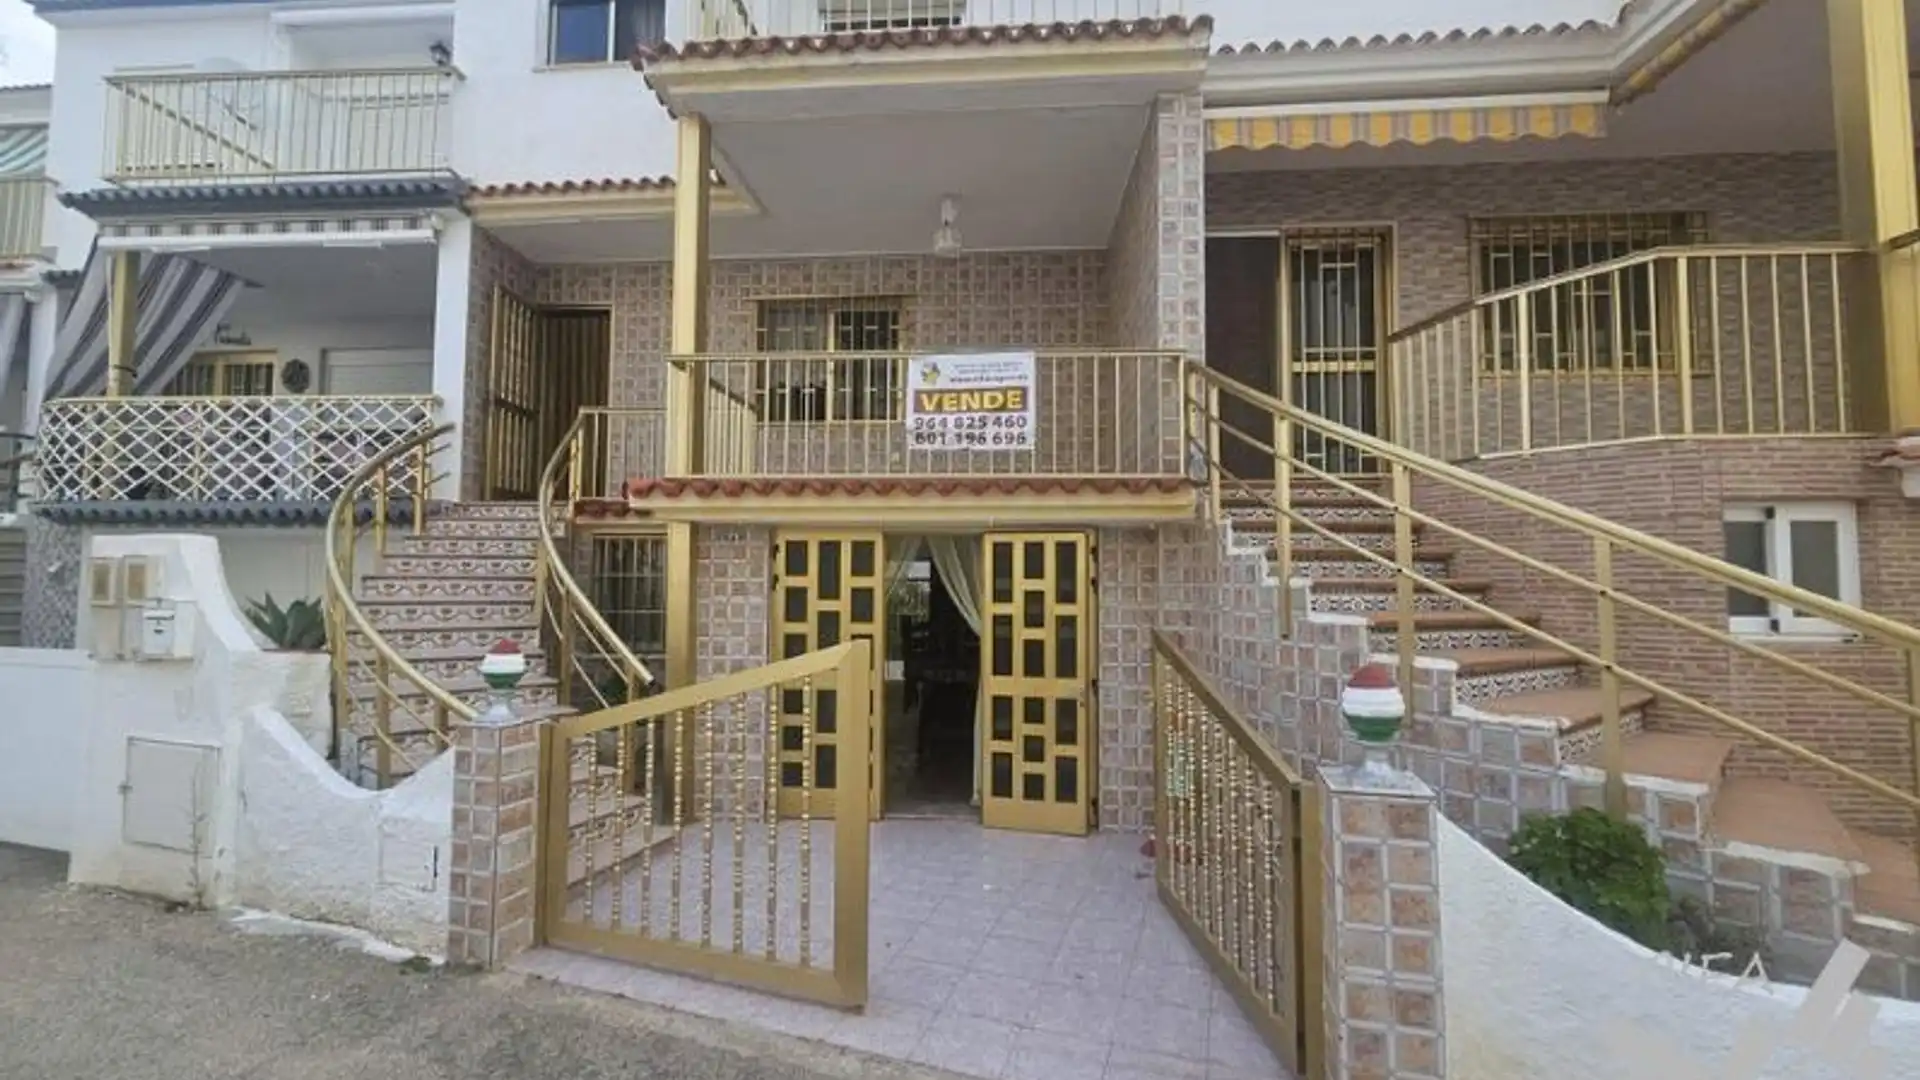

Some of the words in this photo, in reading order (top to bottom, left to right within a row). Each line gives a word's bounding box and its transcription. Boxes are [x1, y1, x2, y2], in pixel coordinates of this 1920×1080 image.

[921, 390, 1023, 411] VENDE
[992, 415, 1027, 428] 460
[915, 432, 946, 445] 601
[992, 431, 1027, 445] 696
